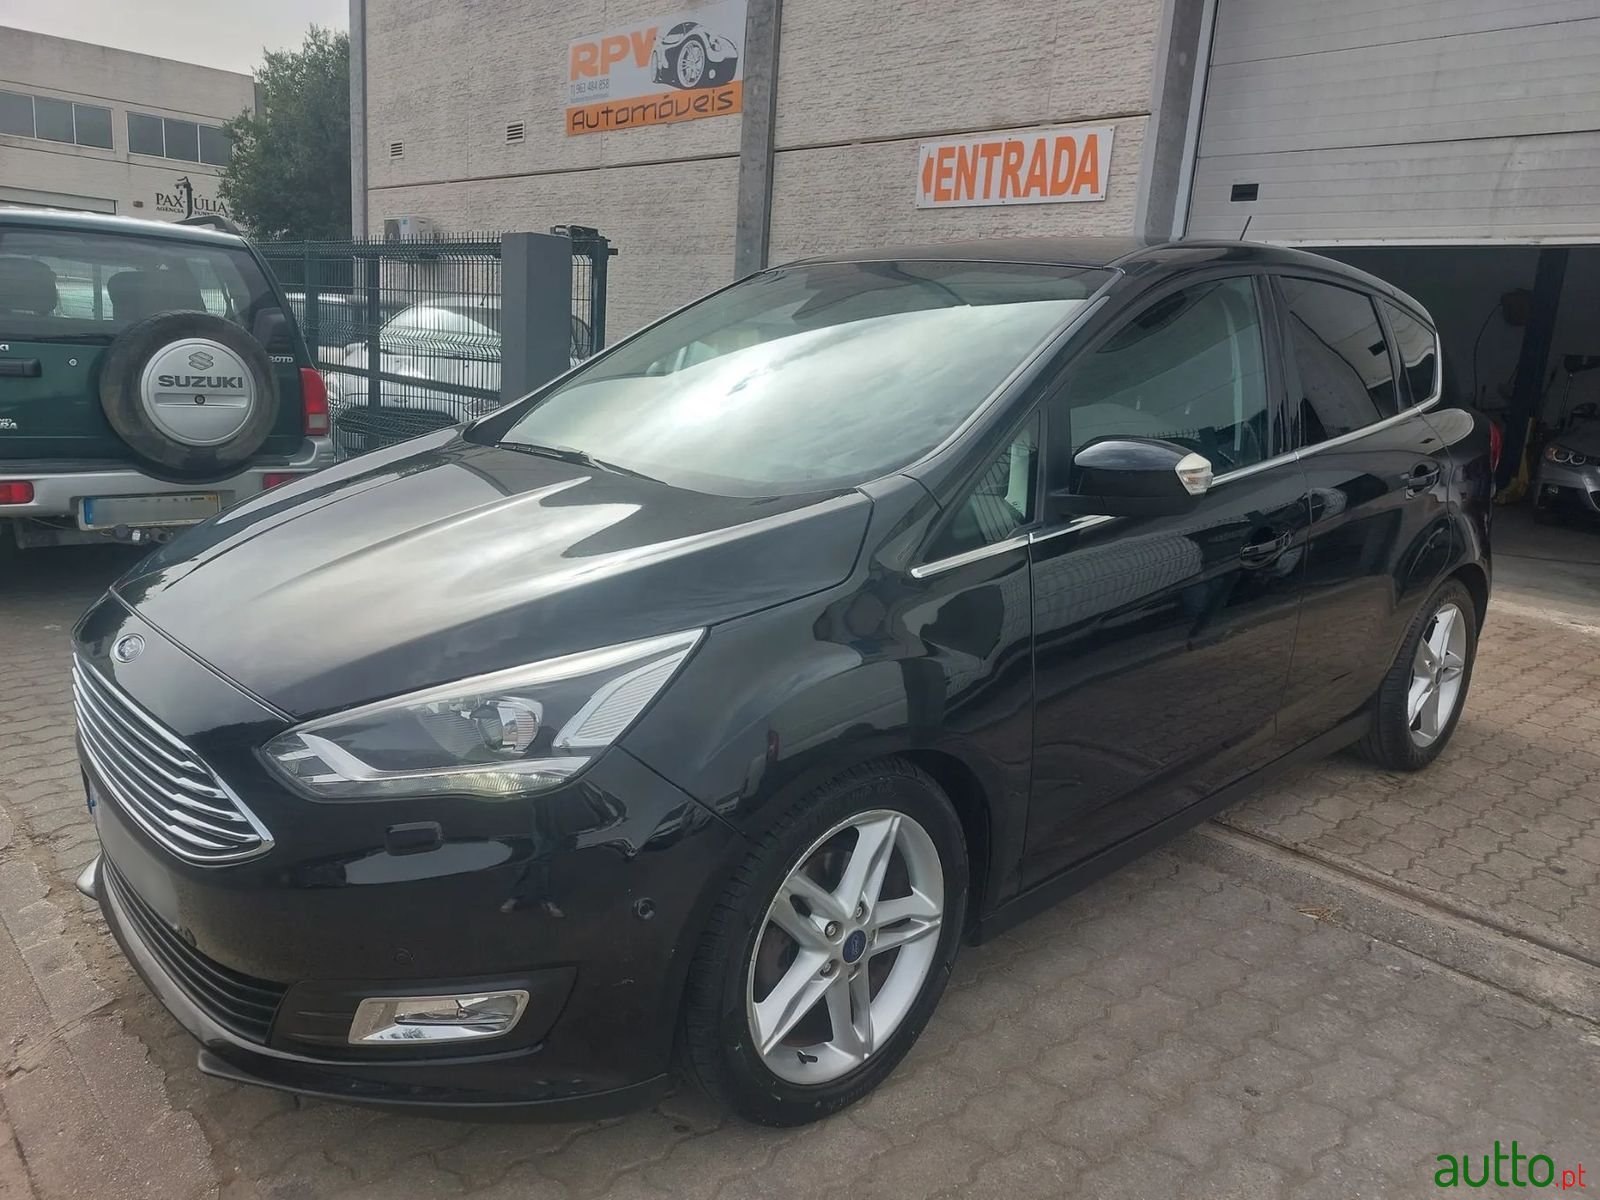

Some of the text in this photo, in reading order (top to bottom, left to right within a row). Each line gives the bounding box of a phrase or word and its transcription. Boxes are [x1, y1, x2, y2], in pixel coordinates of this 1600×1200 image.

[571, 26, 659, 81] RPV
[934, 134, 1099, 202] ENTRADA
[158, 375, 244, 389] SUZUKI
